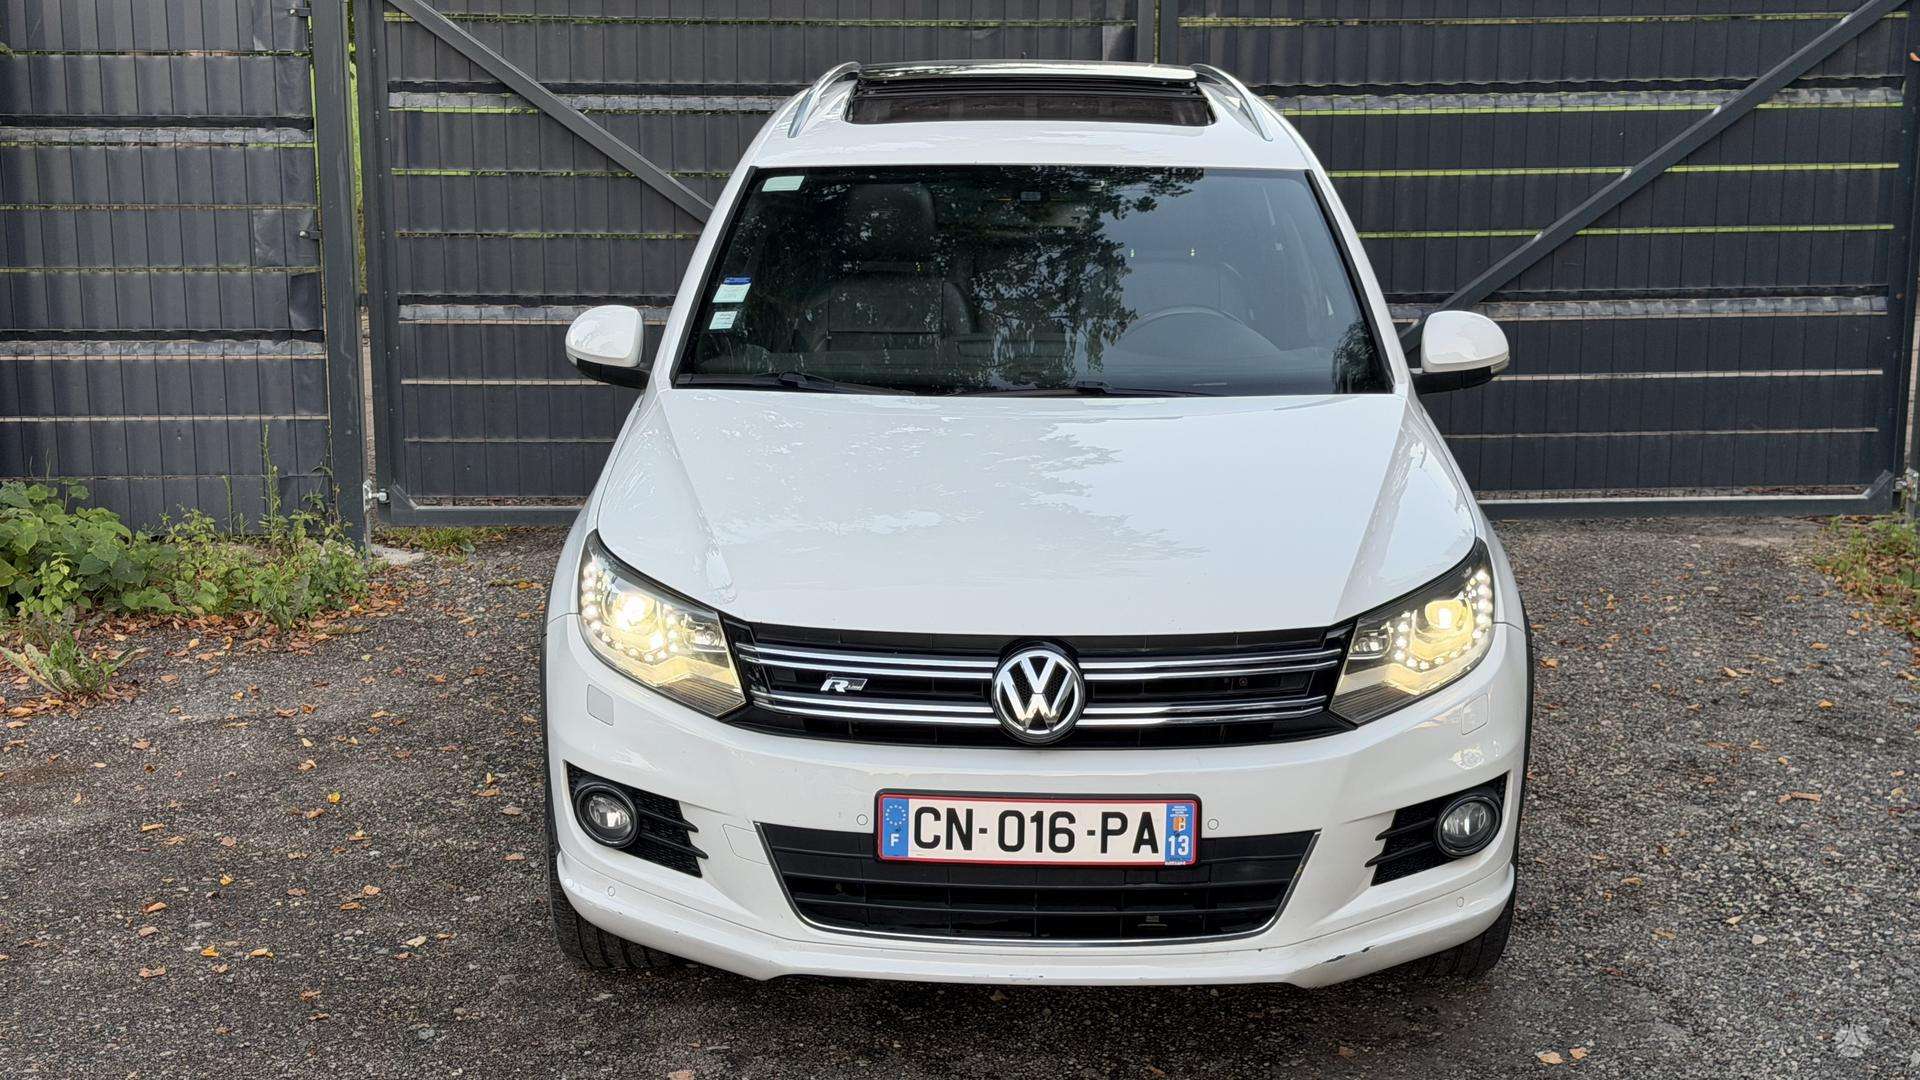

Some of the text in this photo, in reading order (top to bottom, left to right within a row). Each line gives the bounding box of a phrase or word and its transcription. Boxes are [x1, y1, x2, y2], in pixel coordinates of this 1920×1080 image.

[890, 833, 900, 847] F
[913, 806, 1159, 854] CN-016-PA
[1168, 835, 1190, 856] 13
